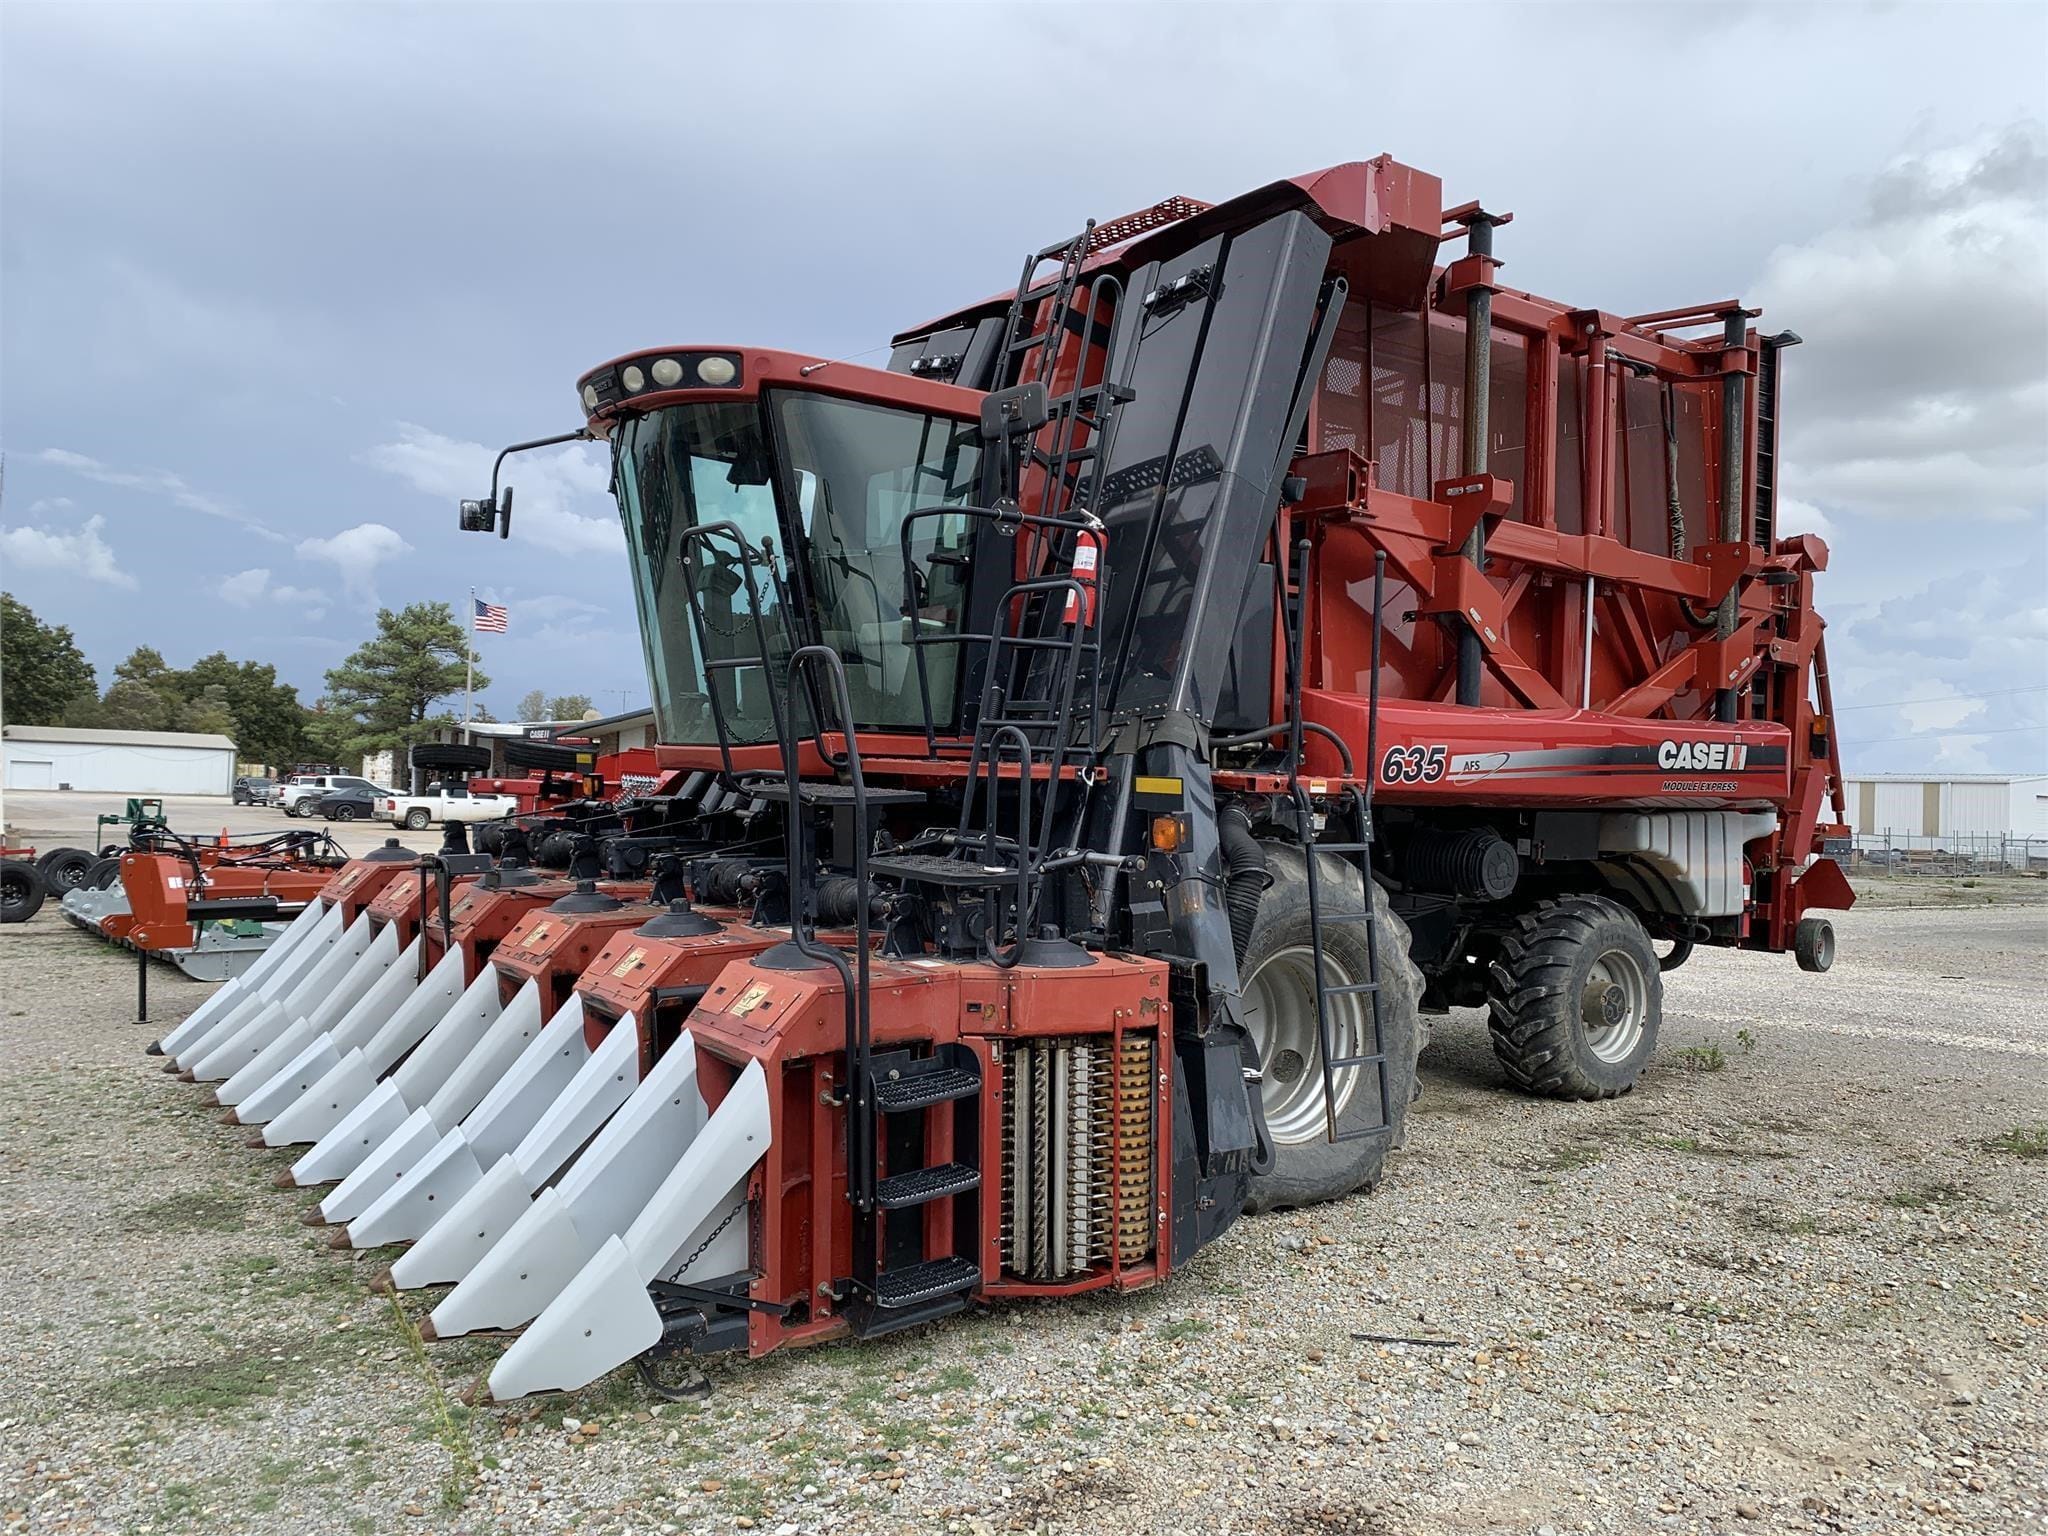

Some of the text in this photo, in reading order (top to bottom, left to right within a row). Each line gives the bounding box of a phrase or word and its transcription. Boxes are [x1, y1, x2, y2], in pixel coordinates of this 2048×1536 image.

[529, 730, 544, 739] CASE
[1658, 740, 1725, 770] CASE
[1381, 745, 1448, 785] 635
[1463, 760, 1481, 771] AFS
[1662, 781, 1738, 793] MODULE EXPRESS
